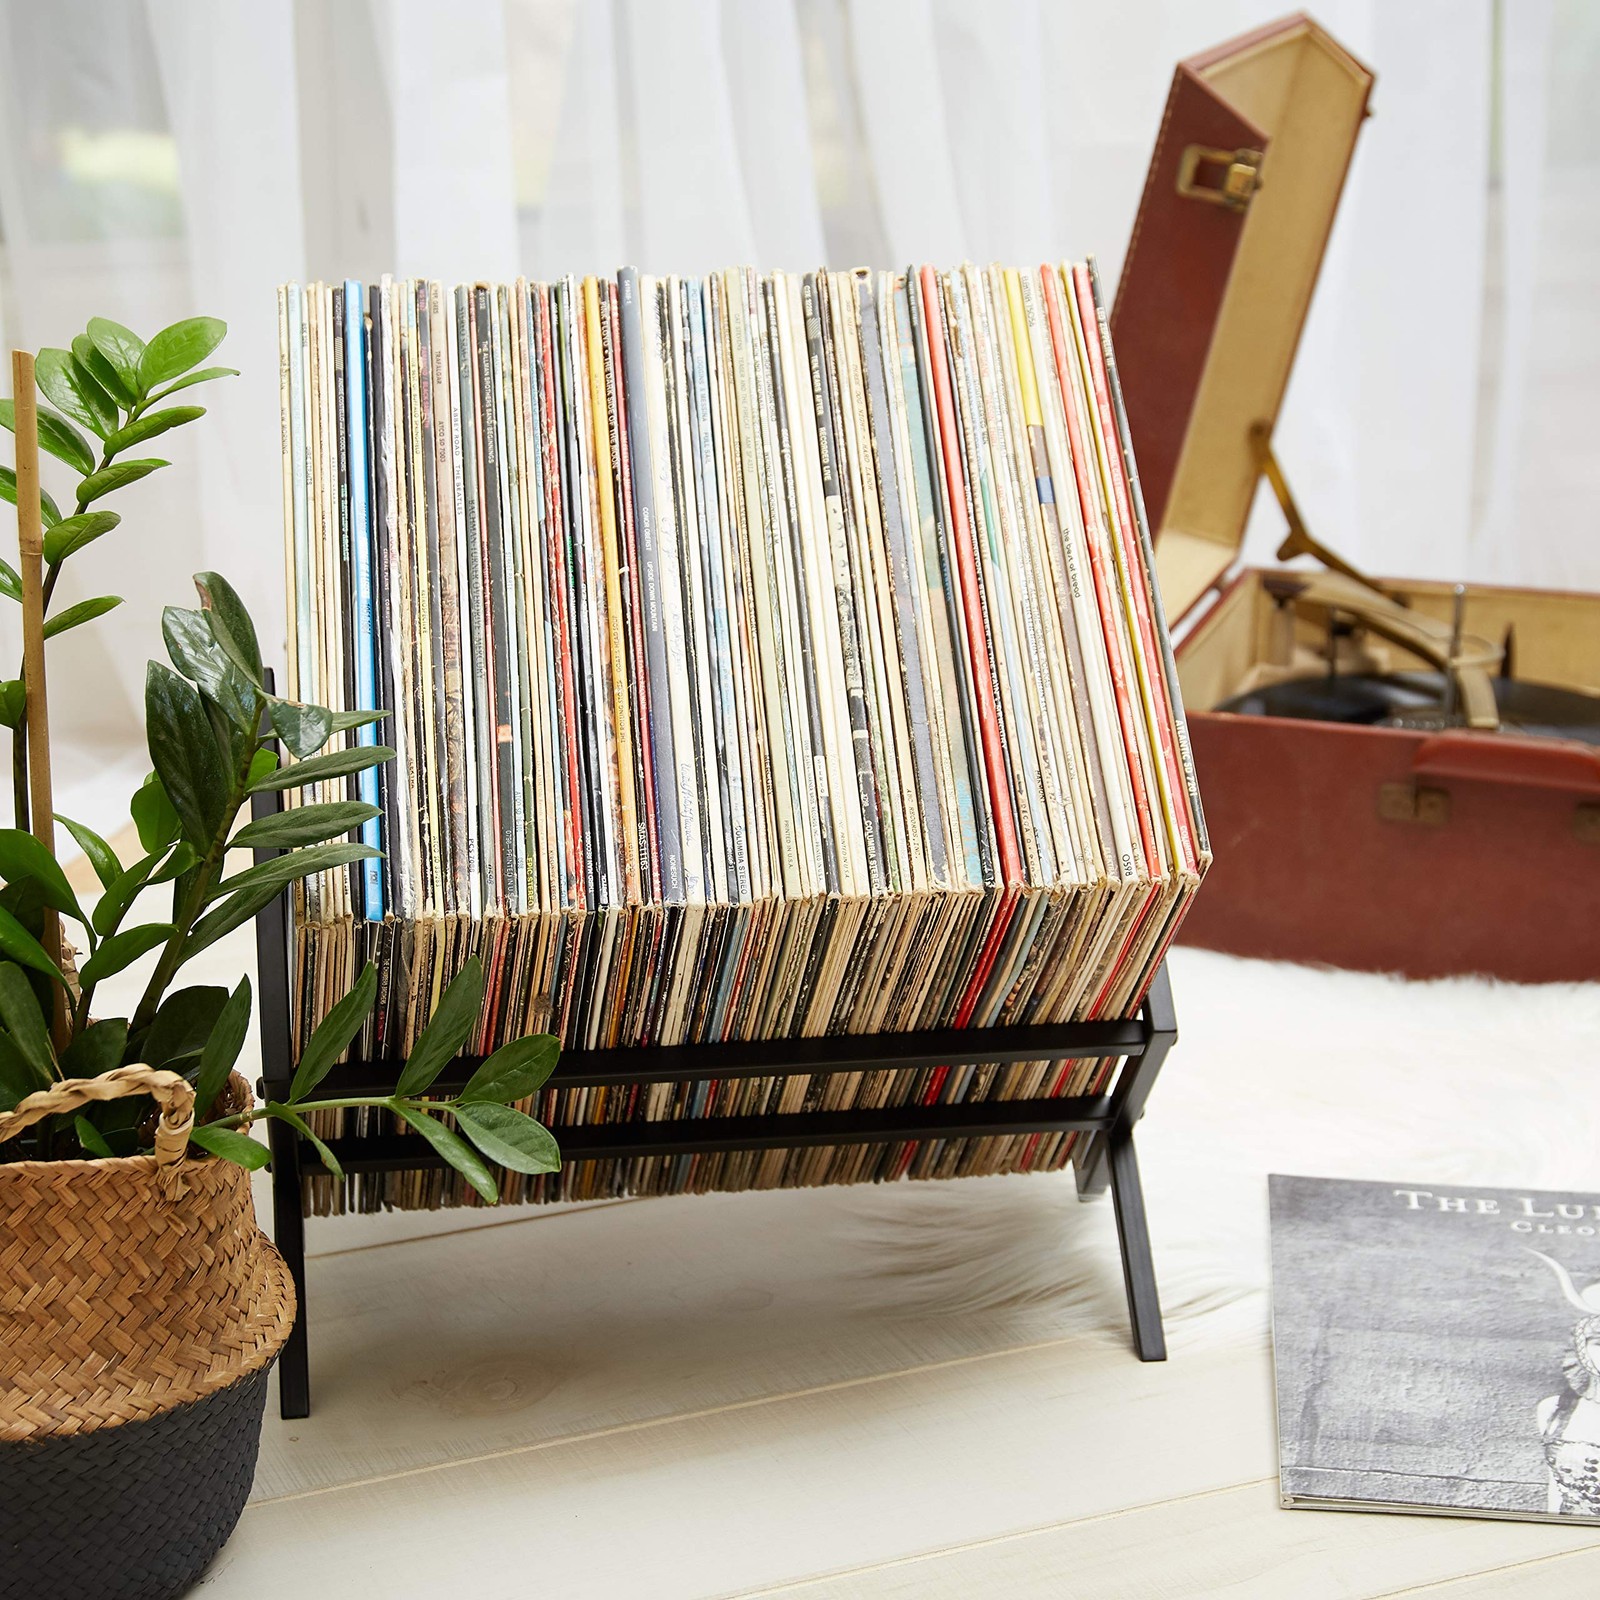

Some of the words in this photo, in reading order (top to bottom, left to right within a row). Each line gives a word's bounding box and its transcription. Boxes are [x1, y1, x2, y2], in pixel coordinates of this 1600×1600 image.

[599, 301, 607, 318] PINK
[600, 320, 609, 347] FLOYD
[734, 326, 743, 350] STEVENS
[420, 345, 428, 375] PARANOID
[434, 350, 442, 385] TRAFALGAR
[695, 356, 705, 385] LOGGINS
[737, 356, 745, 378] TEASER
[810, 354, 819, 368] TEN
[421, 381, 429, 401] BLACK
[483, 376, 491, 407] BROTHERS
[604, 372, 614, 394] DARK
[739, 379, 747, 392] AND
[811, 370, 822, 392] YEARS
[337, 395, 345, 421] COSTELLO
[411, 393, 419, 418] BUFFALO
[606, 396, 615, 411] SIDE
[698, 393, 708, 422] MESSINA
[740, 393, 748, 405] THE
[814, 394, 825, 415] AFTER
[451, 407, 459, 431] ABBEY
[741, 406, 750, 429] FIRECAT
[751, 337, 759, 356] SIMON
[763, 451, 774, 490] WEDNESDAY
[280, 423, 288, 454] MORNING
[412, 419, 421, 455] SPRINGFIELD
[437, 420, 445, 437] ATCO
[484, 408, 495, 463] BAND/BEGINNINGS
[609, 426, 617, 444] THE
[702, 431, 710, 447] FULL
[453, 433, 461, 456] ROAD
[817, 427, 831, 464] RECORDED
[609, 445, 619, 469] MOON
[822, 465, 831, 480] LIVE
[454, 482, 463, 515] BEATLES
[641, 506, 650, 527] CONOR
[466, 499, 480, 580] BACHMAN-TURNER
[643, 528, 652, 551] OBERST
[1062, 527, 1071, 542] the
[1064, 543, 1075, 562] best
[1098, 322, 1113, 356] ZEPPELIN
[1175, 719, 1190, 759] ATLANTIC
[1185, 775, 1197, 796] 7201
[646, 561, 654, 582] UPSIDE
[647, 582, 656, 600] DOWN
[1070, 573, 1081, 598] bread
[470, 582, 482, 630] OVERDRIVE
[648, 601, 659, 632] MOUNTAIN
[473, 639, 484, 680] MERCURY
[905, 788, 914, 805] ABC
[782, 819, 791, 843] PRINTED
[863, 819, 877, 858] COLUMBIA
[467, 837, 475, 853] PCS
[733, 825, 746, 863] COLUMBIA
[1179, 825, 1193, 863] COLUMBIA
[525, 857, 533, 875] EPIC
[668, 854, 679, 889] NONESUCH
[869, 859, 881, 888] STEREO
[526, 877, 535, 906] STEREO
[737, 865, 748, 895] STEREO
[1393, 1190, 1500, 1214] THE
